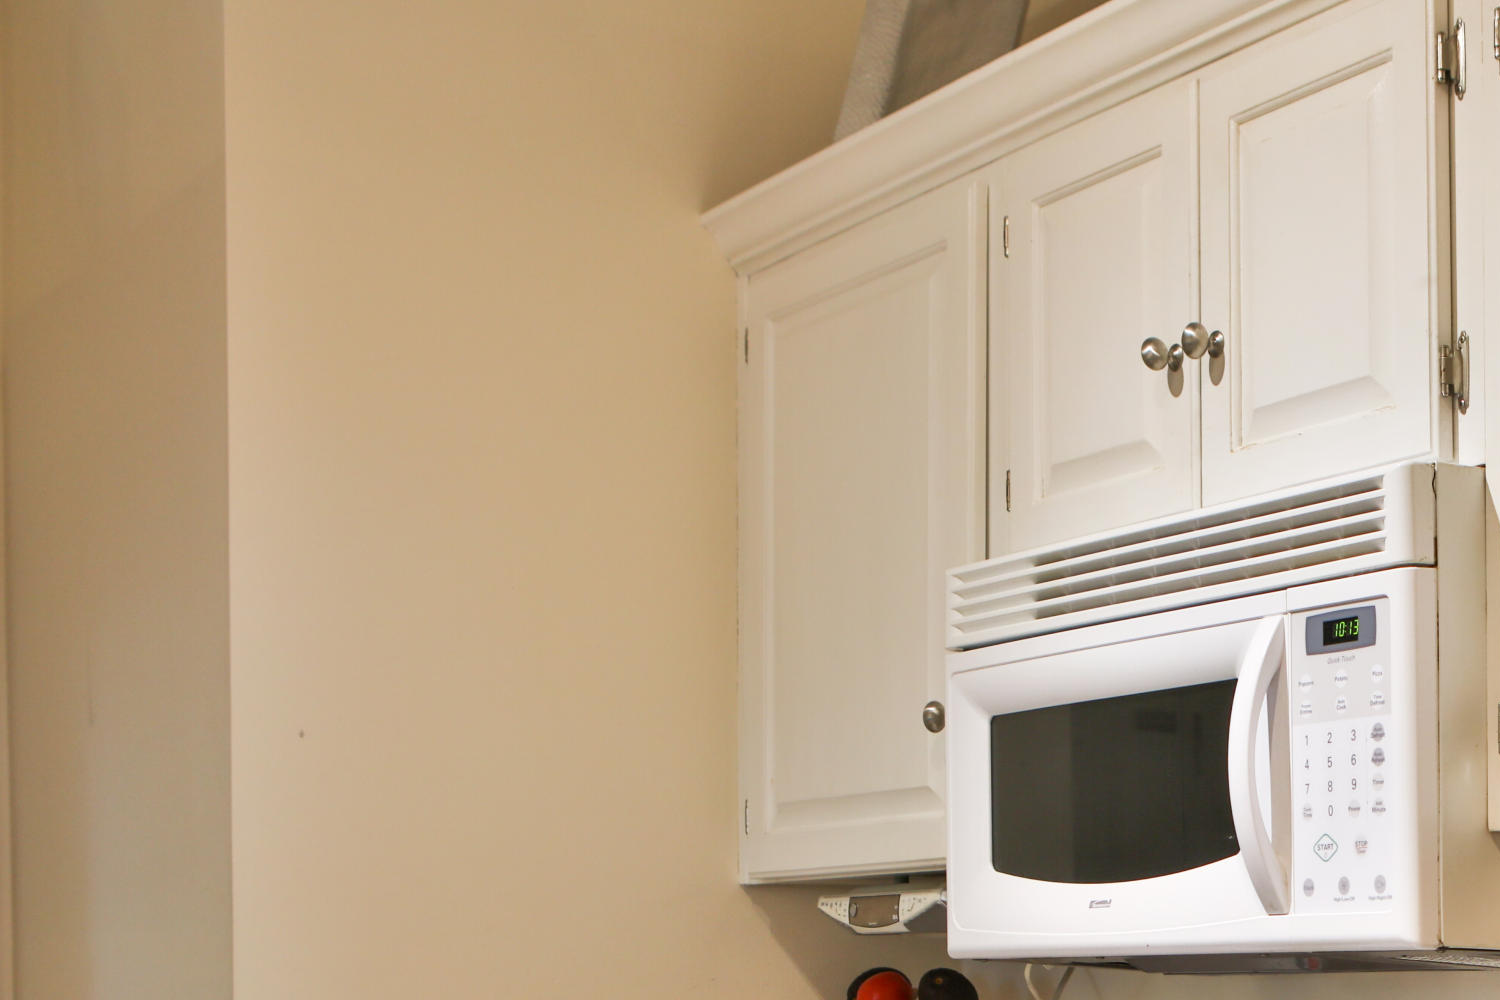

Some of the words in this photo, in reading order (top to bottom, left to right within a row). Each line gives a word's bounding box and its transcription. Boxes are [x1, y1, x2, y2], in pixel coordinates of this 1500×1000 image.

[1335, 619, 1359, 637] 10:13
[1304, 735, 1309, 746] 1
[1327, 732, 1333, 744] 2
[1350, 729, 1357, 742] 3
[1304, 759, 1310, 770] 4
[1327, 756, 1333, 768] 5
[1351, 754, 1357, 766] 6
[1304, 783, 1310, 795] 7
[1327, 780, 1333, 792] 8
[1351, 778, 1357, 790] 9
[1328, 804, 1334, 817] 0
[1317, 843, 1334, 851] START
